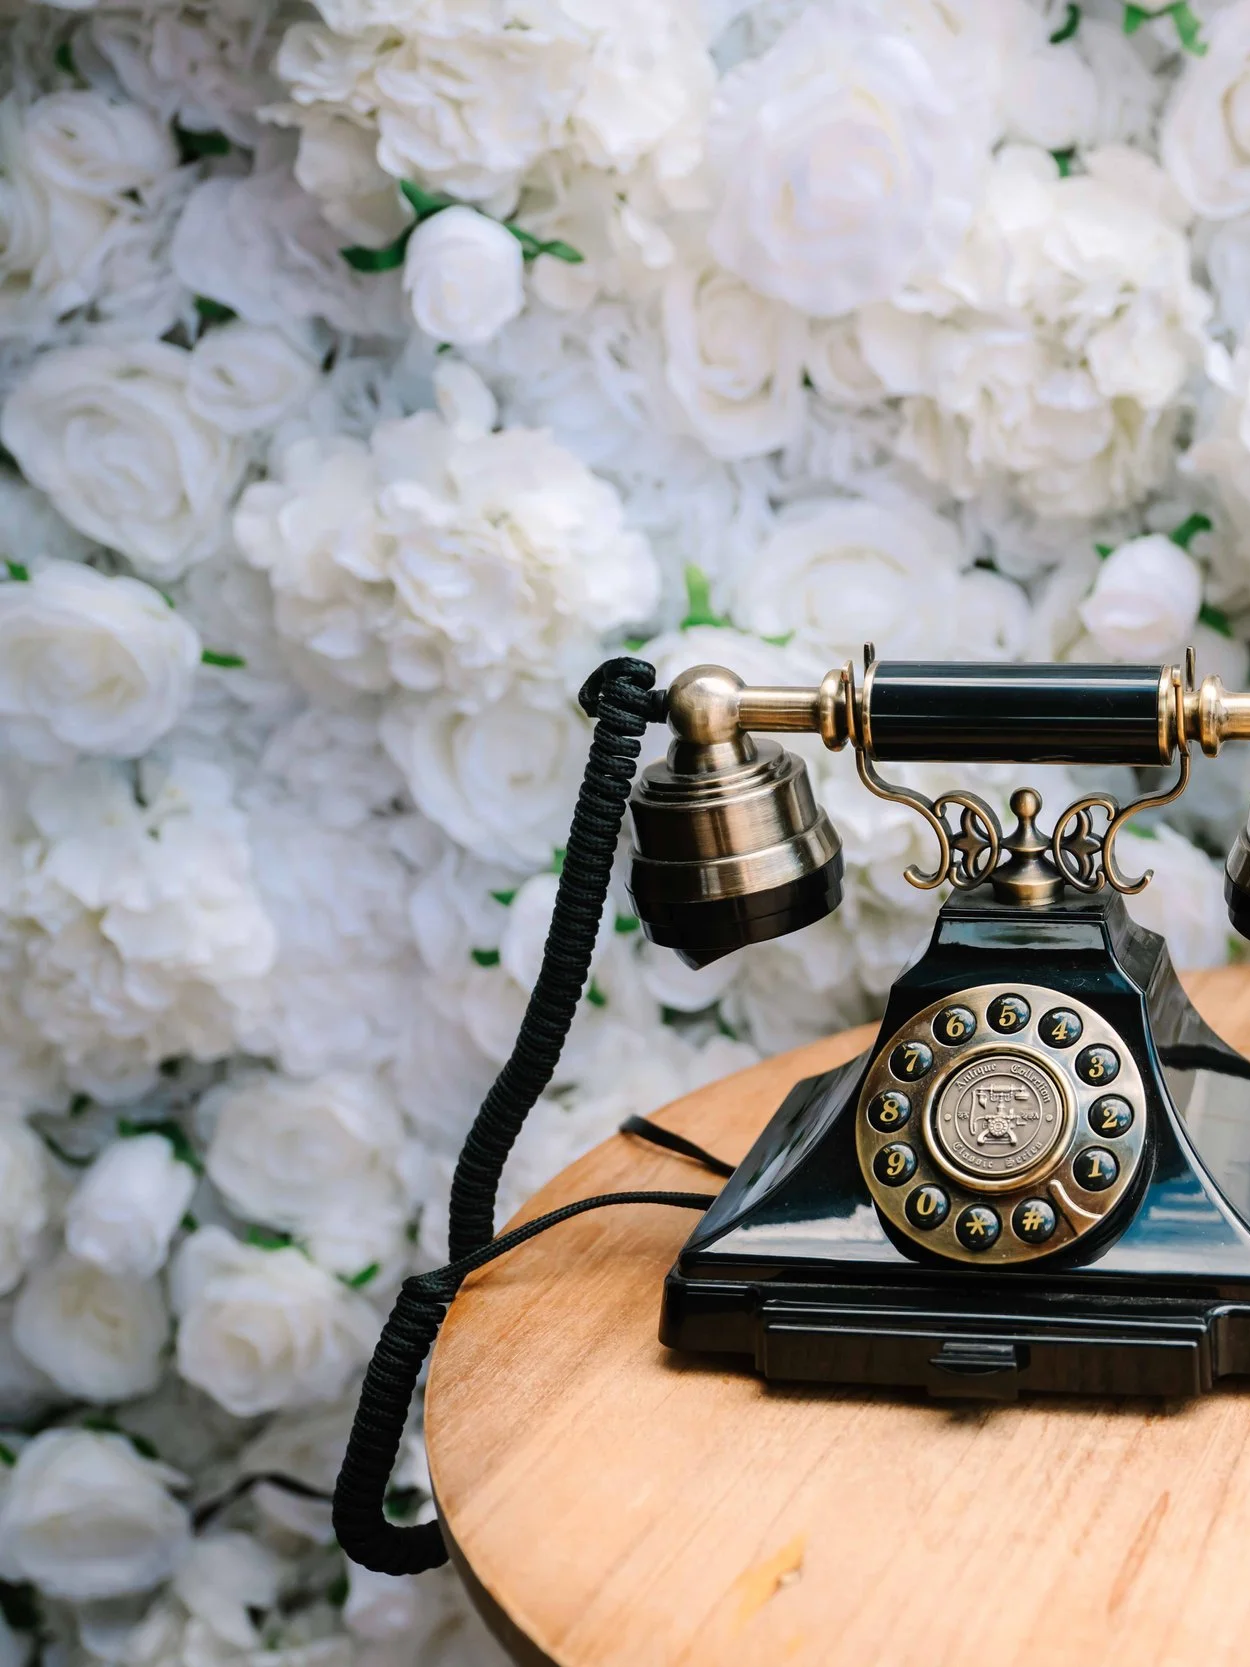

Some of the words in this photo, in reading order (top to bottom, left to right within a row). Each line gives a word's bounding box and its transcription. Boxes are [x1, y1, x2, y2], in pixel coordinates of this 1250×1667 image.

[946, 1014, 965, 1037] 6
[999, 1005, 1017, 1026] 5
[1051, 1017, 1068, 1041] 4
[904, 1049, 920, 1073] 7
[1088, 1055, 1105, 1078] 3
[955, 1062, 997, 1092] Antique
[1010, 1063, 1051, 1104] Collection
[879, 1099, 899, 1122] 8
[1102, 1107, 1118, 1130] 2
[886, 1151, 906, 1176] 9
[953, 1141, 993, 1169] Classic
[1087, 1157, 1103, 1179] 1
[916, 1191, 936, 1216] 0
